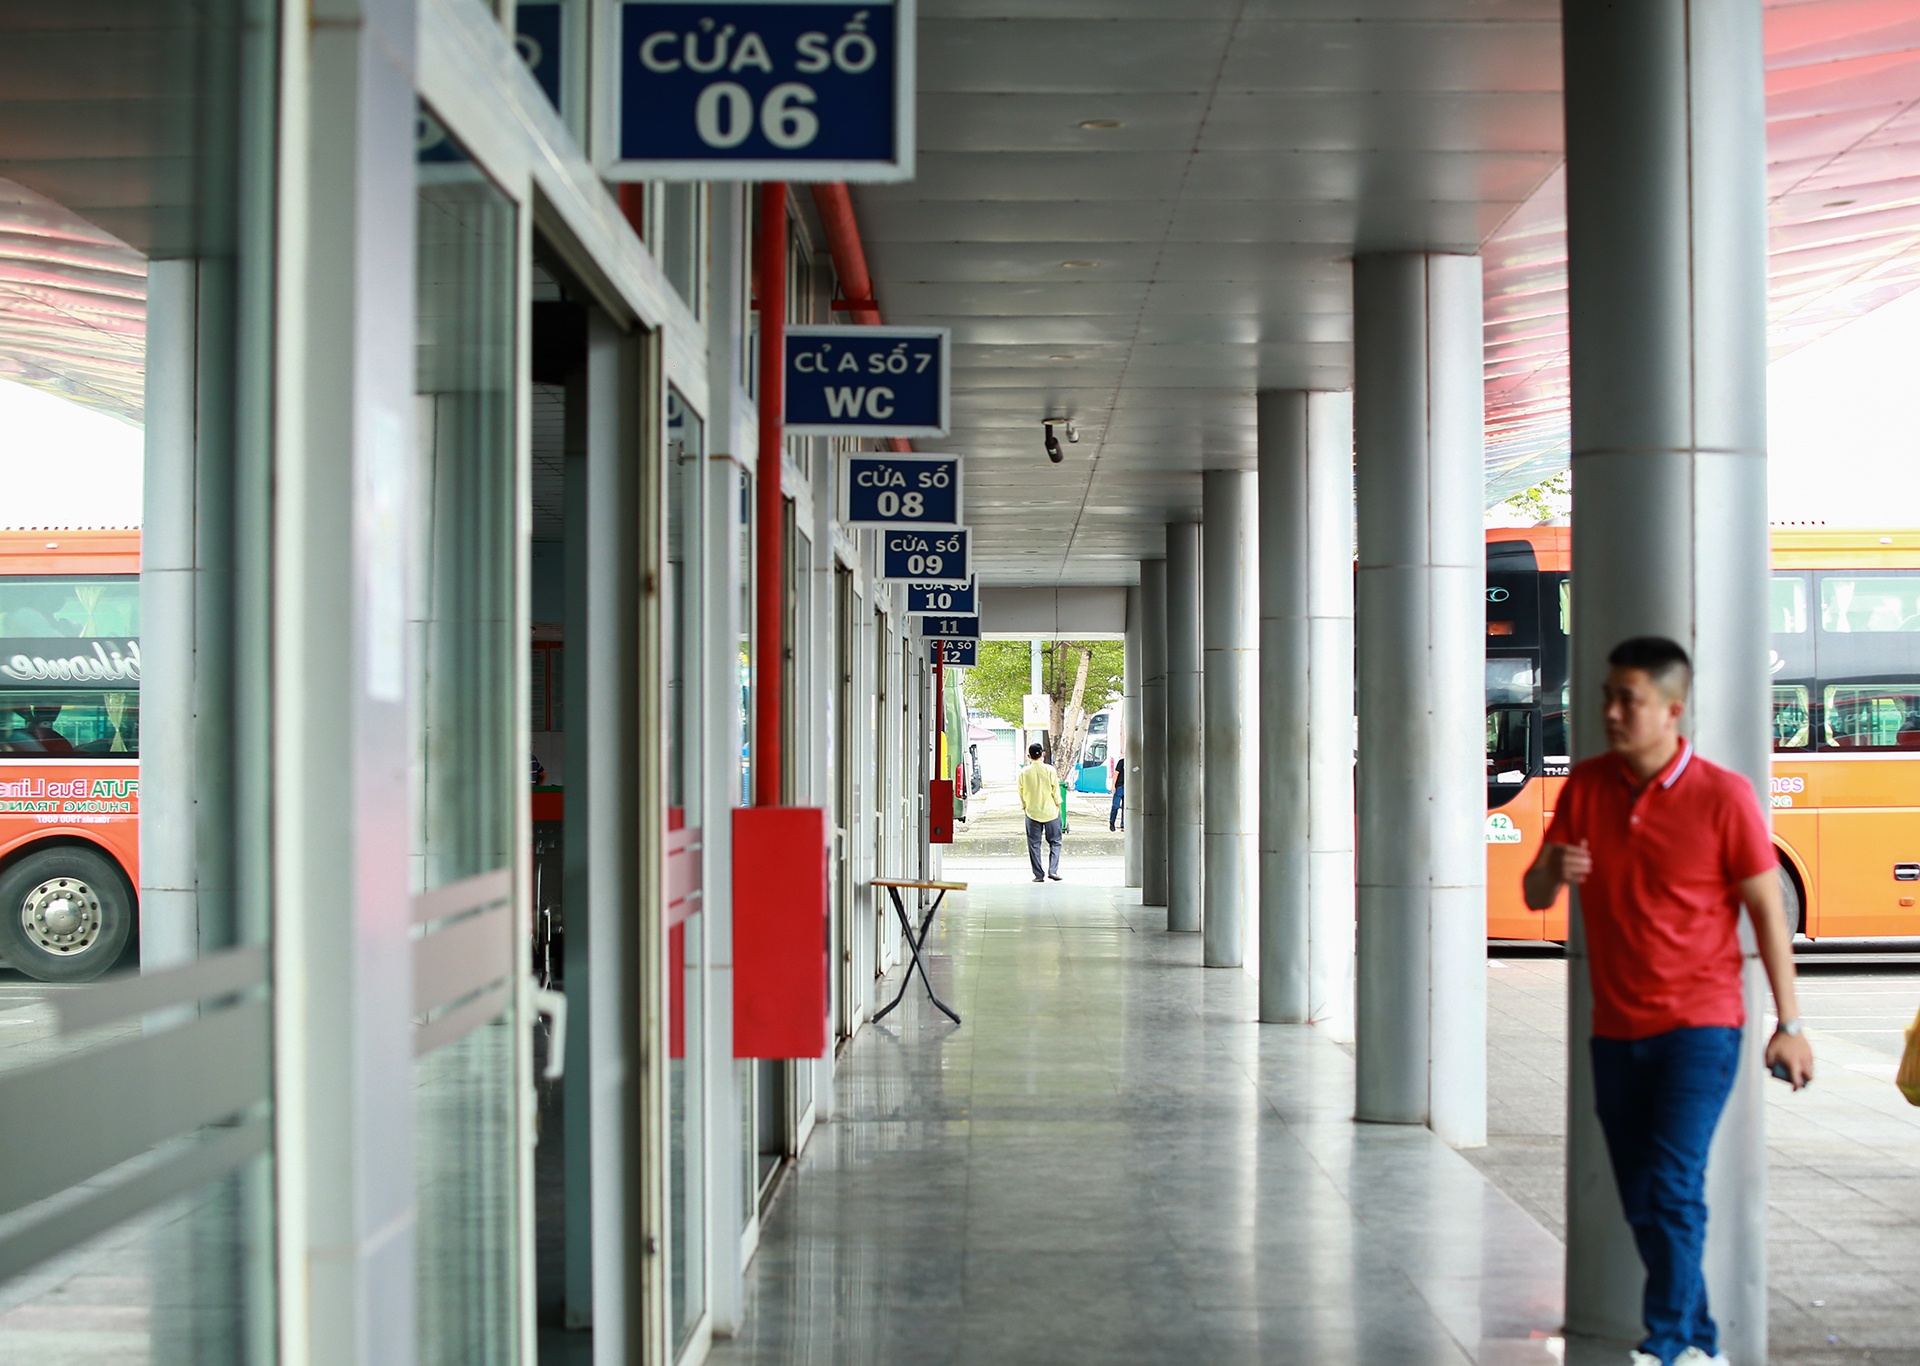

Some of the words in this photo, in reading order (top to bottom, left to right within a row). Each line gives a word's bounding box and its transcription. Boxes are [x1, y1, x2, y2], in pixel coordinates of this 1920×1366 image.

[639, 16, 773, 75] CỬA
[794, 11, 877, 75] SỐ
[695, 81, 820, 150] 06
[868, 342, 909, 374] SỐ
[914, 353, 932, 374] 7
[823, 386, 896, 420] WC
[856, 464, 907, 488] CỬA
[918, 464, 950, 488] SỐ
[877, 491, 924, 518] 08
[890, 534, 929, 552] CỬA
[935, 534, 960, 552] SỐ
[907, 554, 943, 575] 09
[925, 592, 952, 609] 10
[939, 620, 959, 634] 11
[943, 650, 961, 663] 12
[1491, 817, 1507, 829] 42
